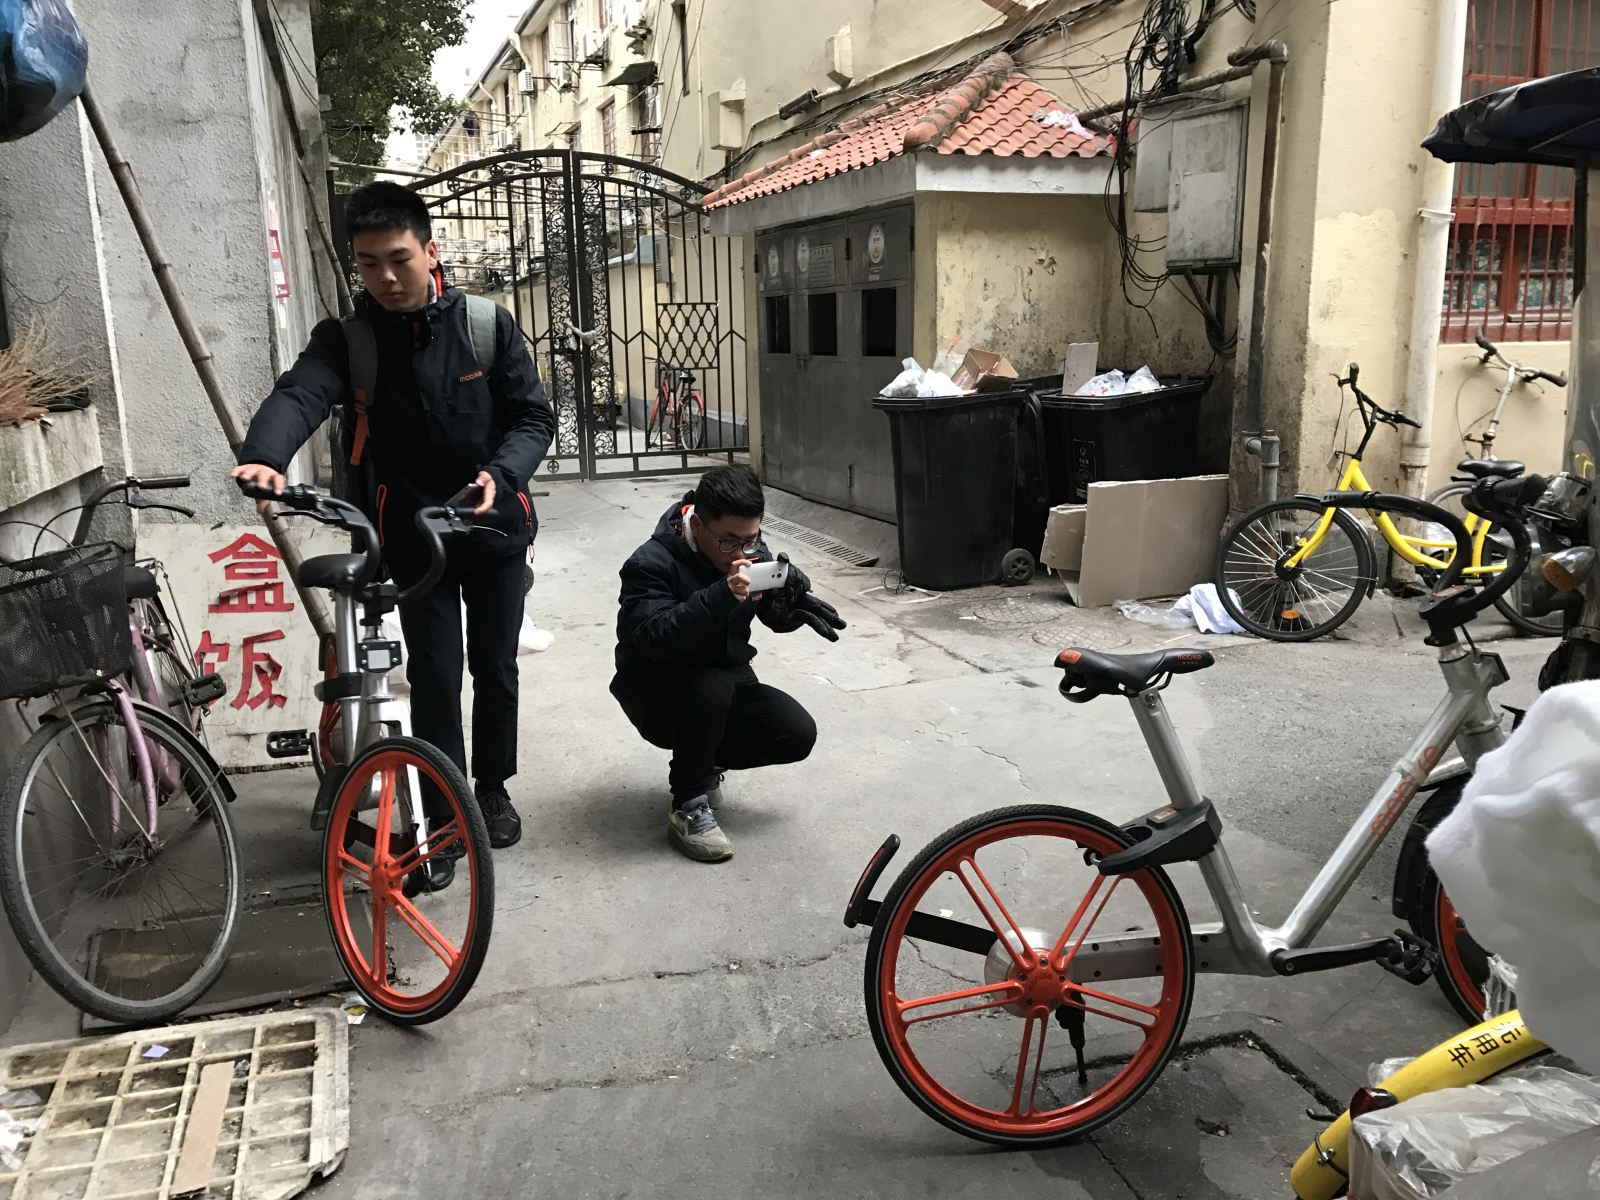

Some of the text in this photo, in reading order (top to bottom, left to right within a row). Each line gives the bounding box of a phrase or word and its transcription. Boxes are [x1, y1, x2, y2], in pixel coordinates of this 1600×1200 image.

[194, 532, 295, 711] 盒饭
[1371, 745, 1441, 836] mobke
[1448, 1021, 1524, 1068] 元用车
